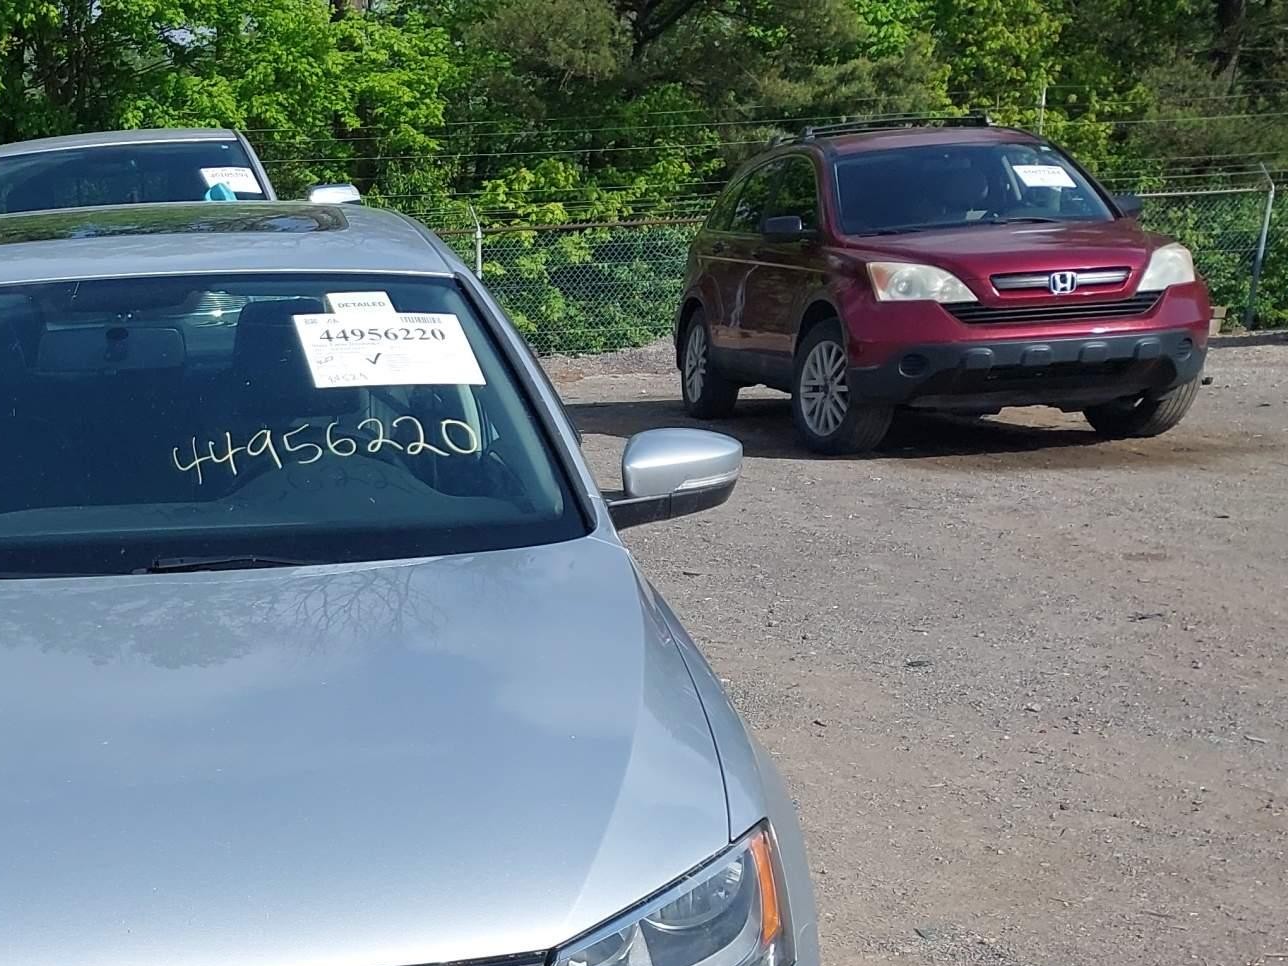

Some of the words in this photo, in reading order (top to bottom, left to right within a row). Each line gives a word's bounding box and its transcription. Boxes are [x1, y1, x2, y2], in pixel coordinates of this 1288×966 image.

[338, 300, 386, 309] DETAILED
[319, 327, 446, 342] 44956220
[172, 415, 479, 485] 44956220
